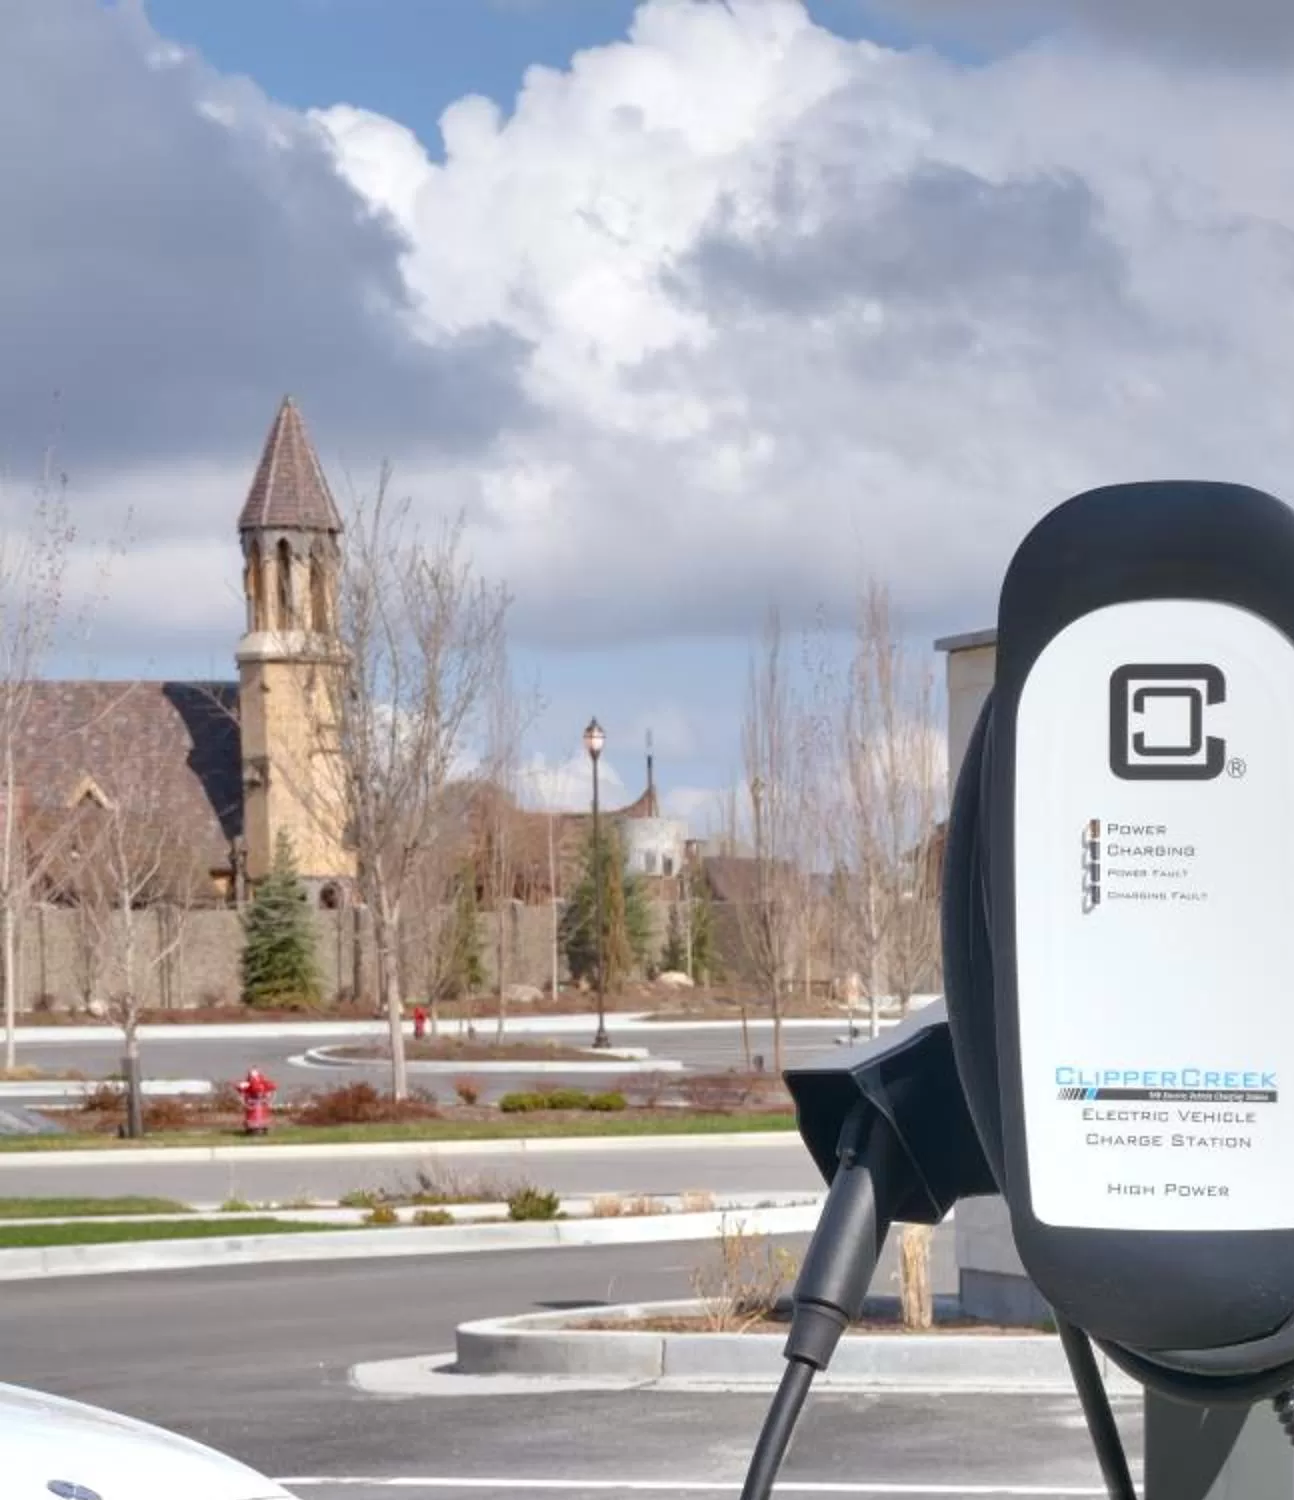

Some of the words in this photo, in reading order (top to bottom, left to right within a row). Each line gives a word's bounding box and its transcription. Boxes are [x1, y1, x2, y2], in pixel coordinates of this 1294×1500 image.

[1082, 1107, 1169, 1122] ELECTRIC
[1177, 1109, 1257, 1124] VEHICLE
[1086, 1133, 1163, 1147] CHARGE
[1171, 1134, 1252, 1149] STATION
[1107, 1183, 1155, 1196] HIGH
[1164, 1183, 1230, 1197] POWER
